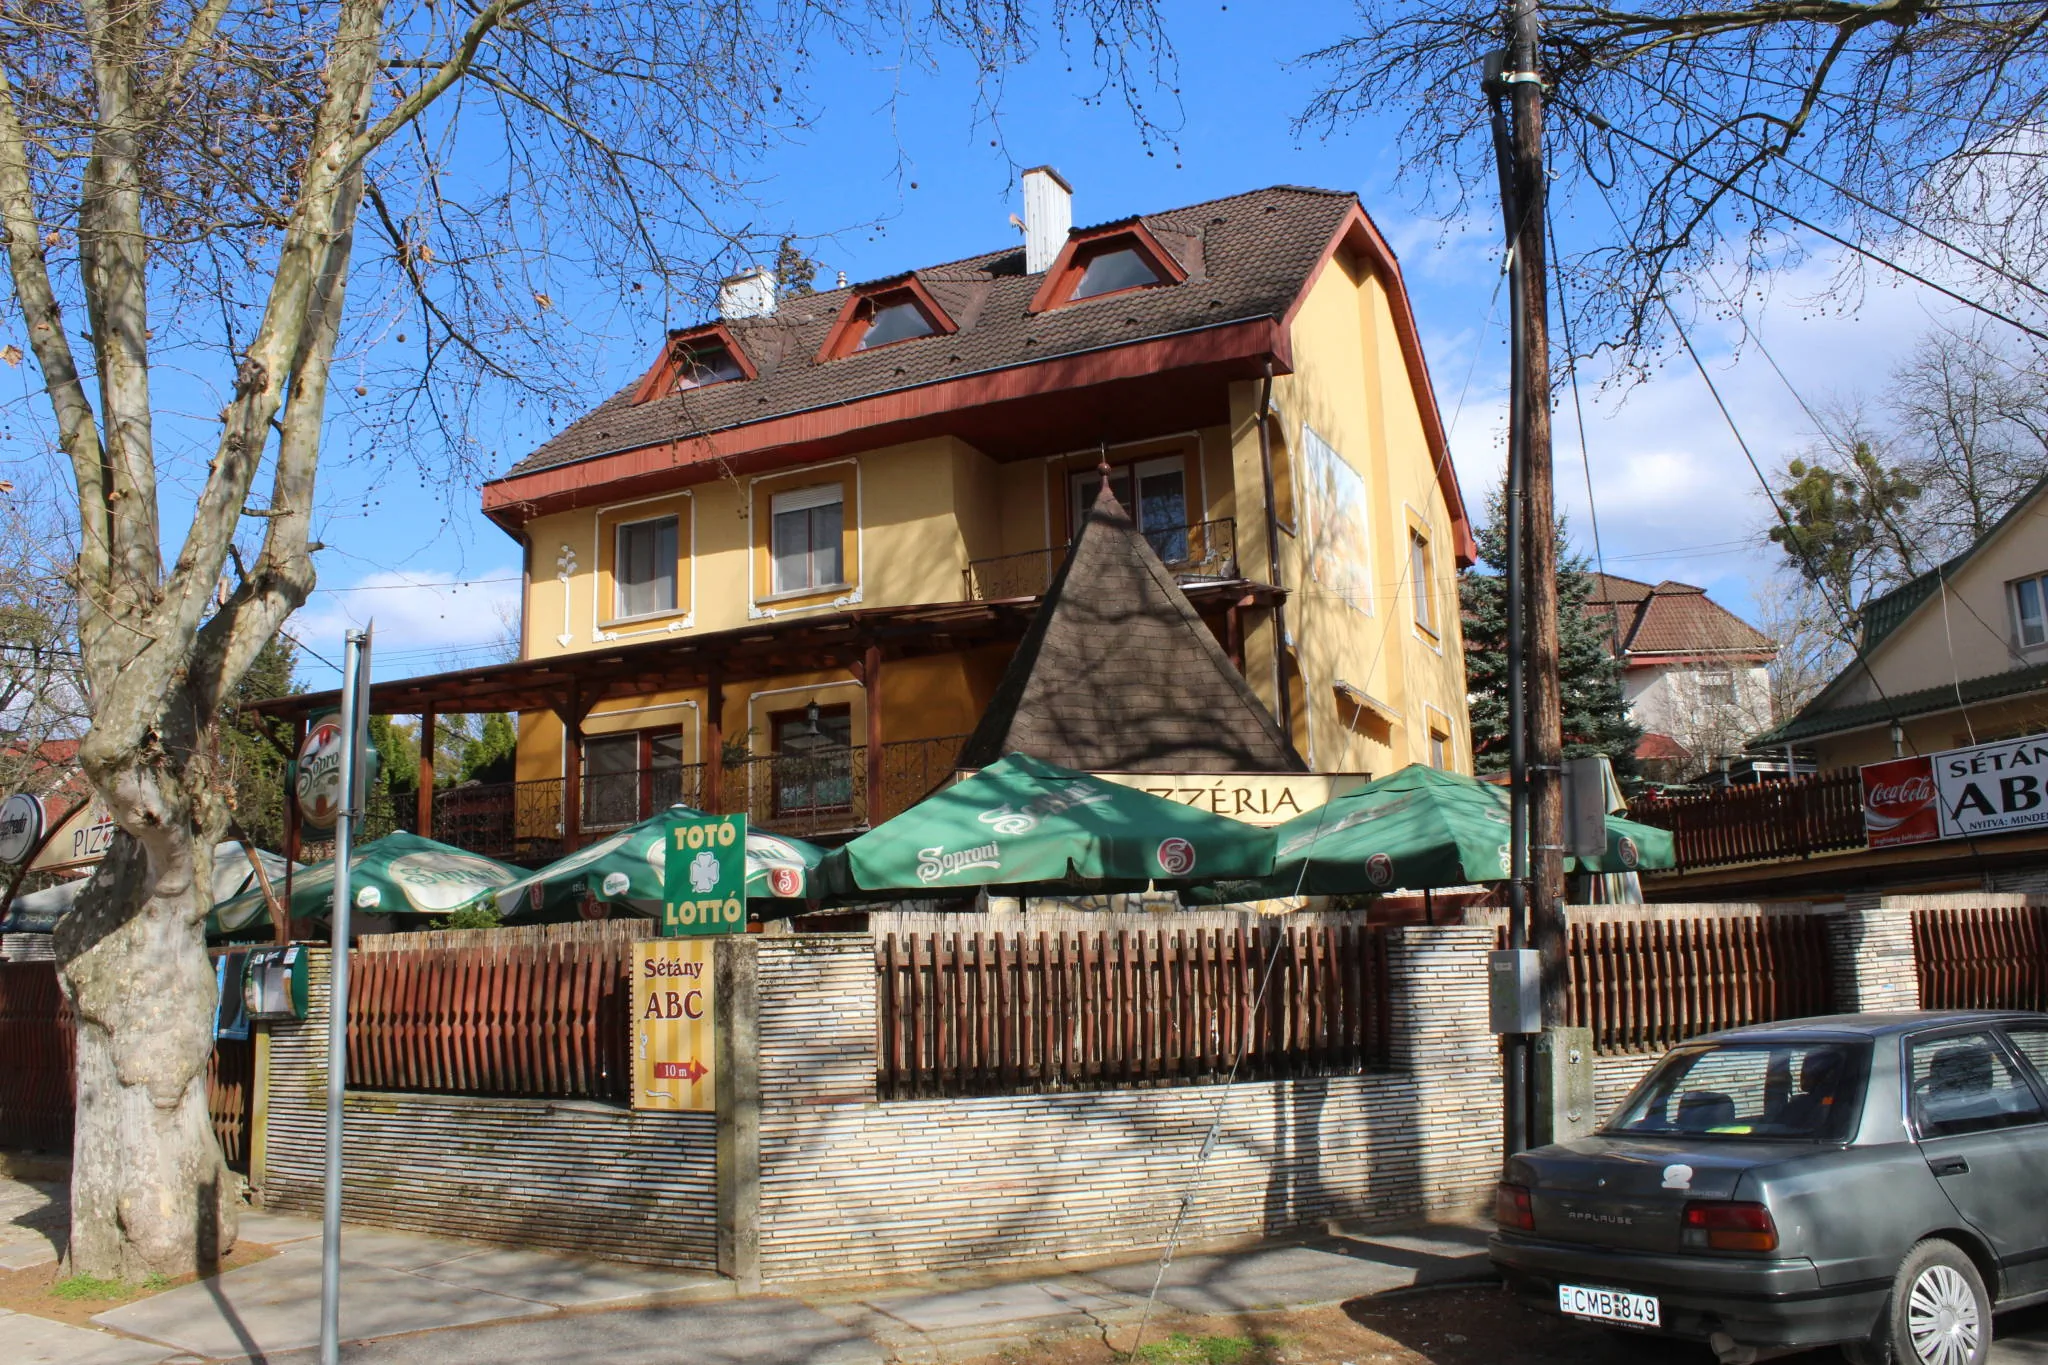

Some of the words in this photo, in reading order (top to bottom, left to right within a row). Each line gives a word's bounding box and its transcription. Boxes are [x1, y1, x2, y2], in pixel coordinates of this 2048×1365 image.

[297, 751, 340, 798] Sopro
[1951, 775, 2048, 820] AB
[674, 815, 736, 851] TOTÓ
[1969, 818, 2008, 830] NYITVA:
[2010, 811, 2048, 825] MINDE
[73, 821, 114, 858] PIZZ
[916, 840, 1001, 885] Soproni
[1164, 840, 1189, 872] S
[1369, 856, 1389, 886] S
[666, 890, 742, 926] LOTTÓ
[644, 957, 704, 979] Sétány
[644, 989, 704, 1019] ABC
[664, 1064, 677, 1077] 10
[678, 1069, 688, 1077] m
[1568, 1211, 1633, 1225] APPLAUSE
[1562, 1298, 1571, 1310] H
